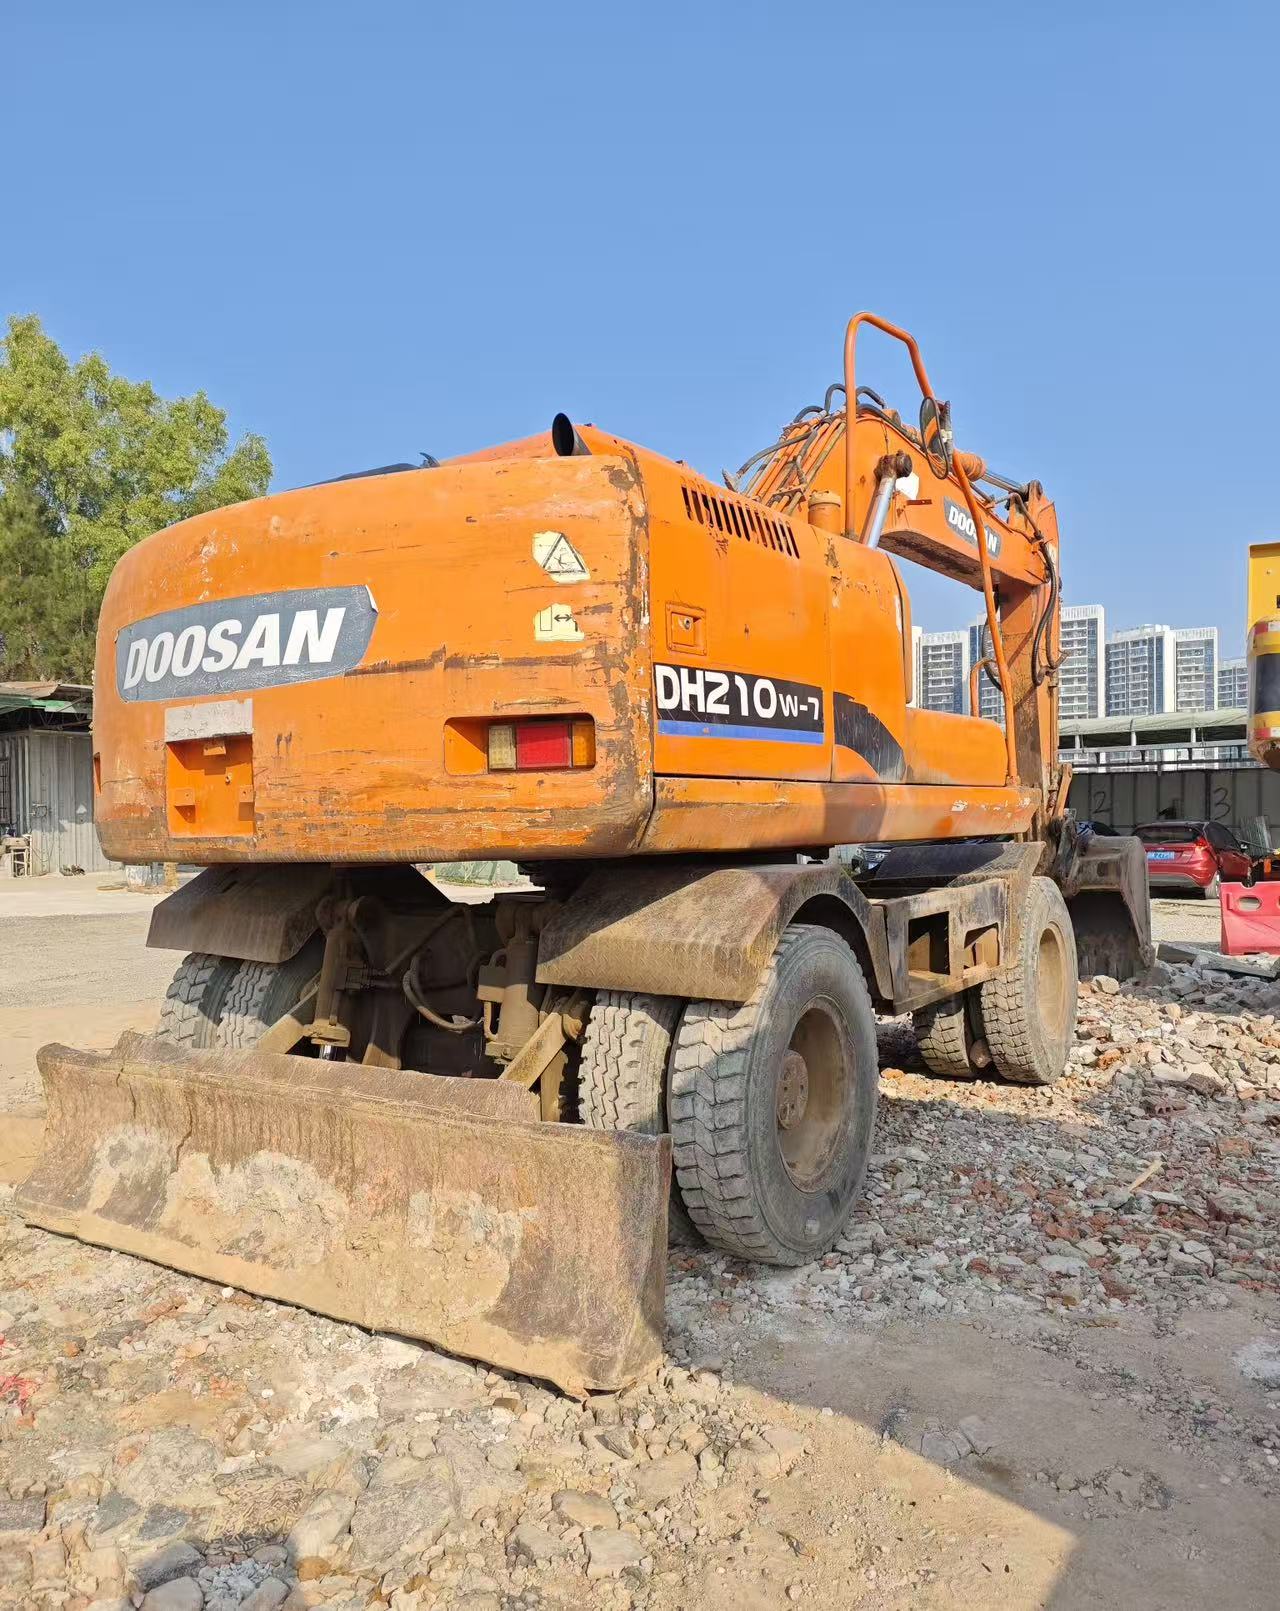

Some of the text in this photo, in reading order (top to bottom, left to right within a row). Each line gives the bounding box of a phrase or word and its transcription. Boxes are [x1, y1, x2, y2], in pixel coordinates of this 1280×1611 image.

[949, 506, 997, 552] DOON
[123, 607, 346, 690] DOOSAN
[1092, 791, 1111, 814] 2
[1213, 787, 1230, 820] 3
